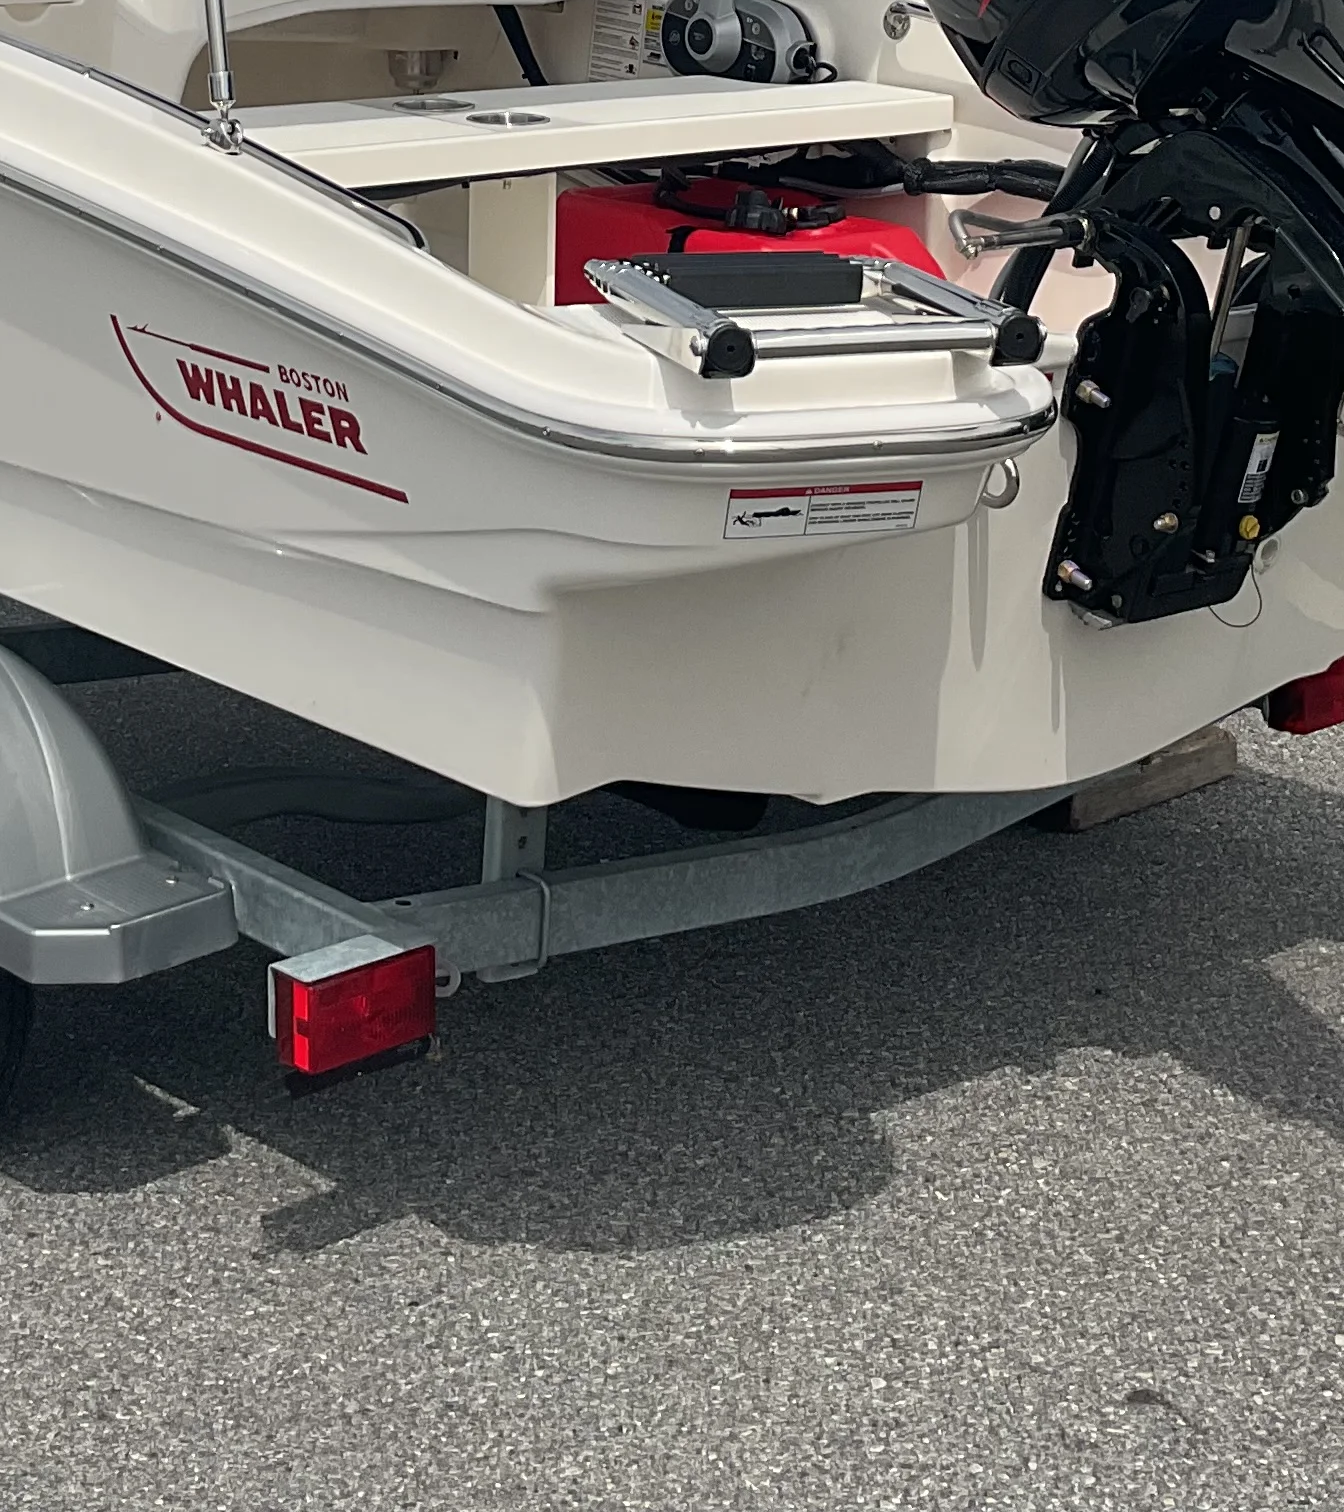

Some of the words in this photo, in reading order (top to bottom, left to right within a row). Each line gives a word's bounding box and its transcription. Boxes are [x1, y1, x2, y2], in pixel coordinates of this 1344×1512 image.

[277, 364, 350, 403] BOSTON
[175, 357, 369, 456] WHALER
[813, 486, 851, 495] DANGER
